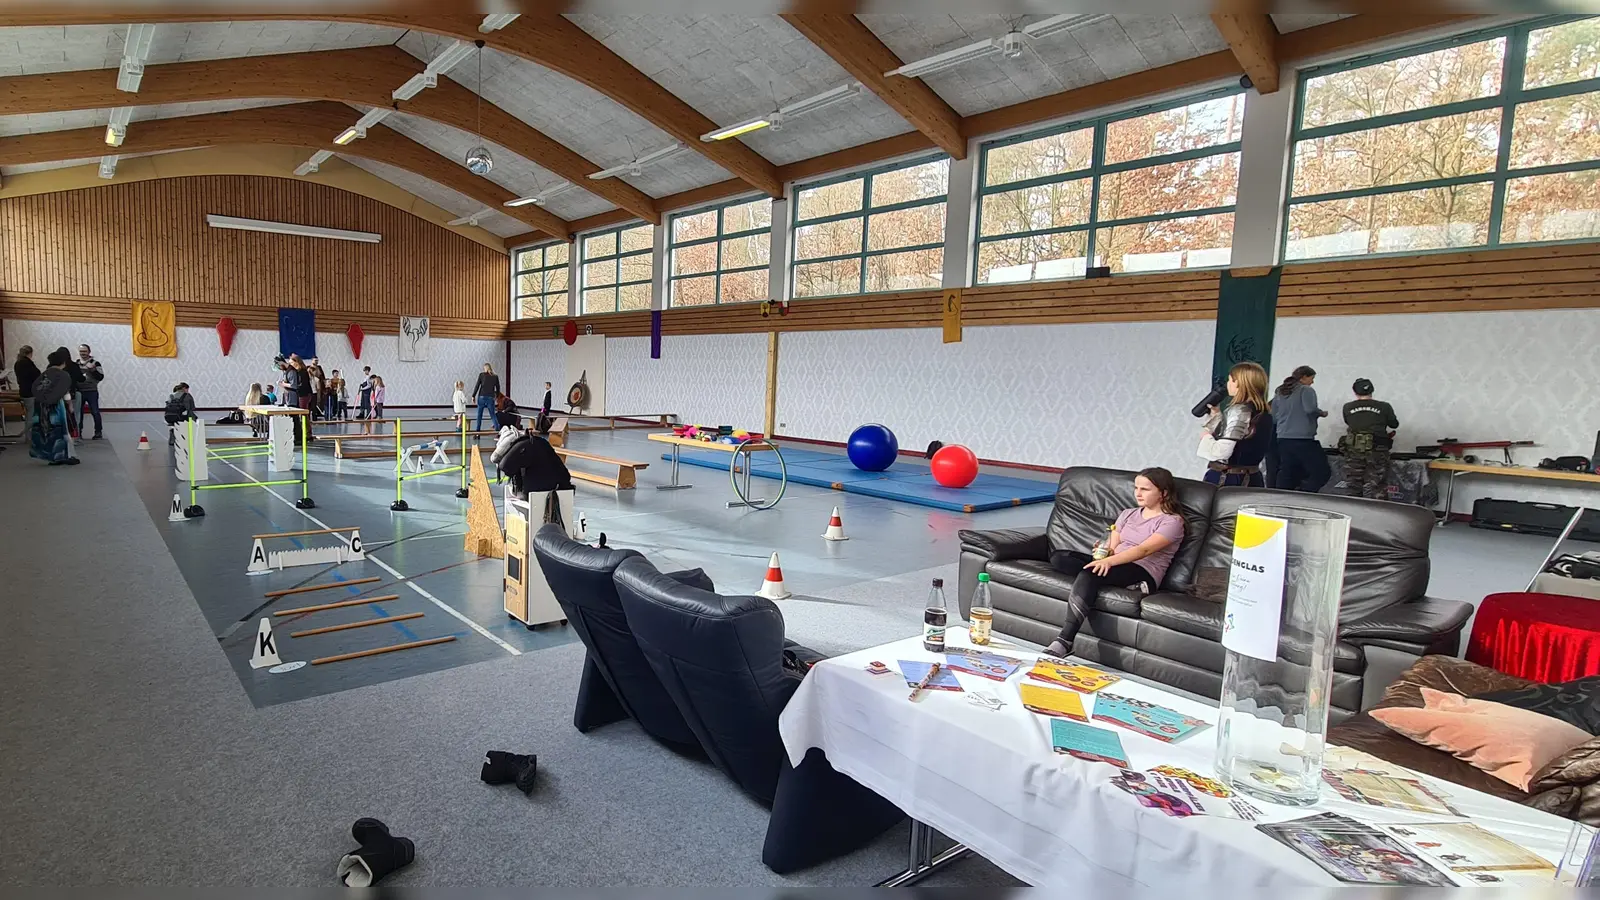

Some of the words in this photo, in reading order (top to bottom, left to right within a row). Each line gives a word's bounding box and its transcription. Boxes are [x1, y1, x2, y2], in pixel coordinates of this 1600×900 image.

[172, 500, 183, 514] M
[580, 519, 587, 533] F
[351, 537, 362, 553] C
[253, 546, 265, 564] A
[259, 631, 276, 657] K
